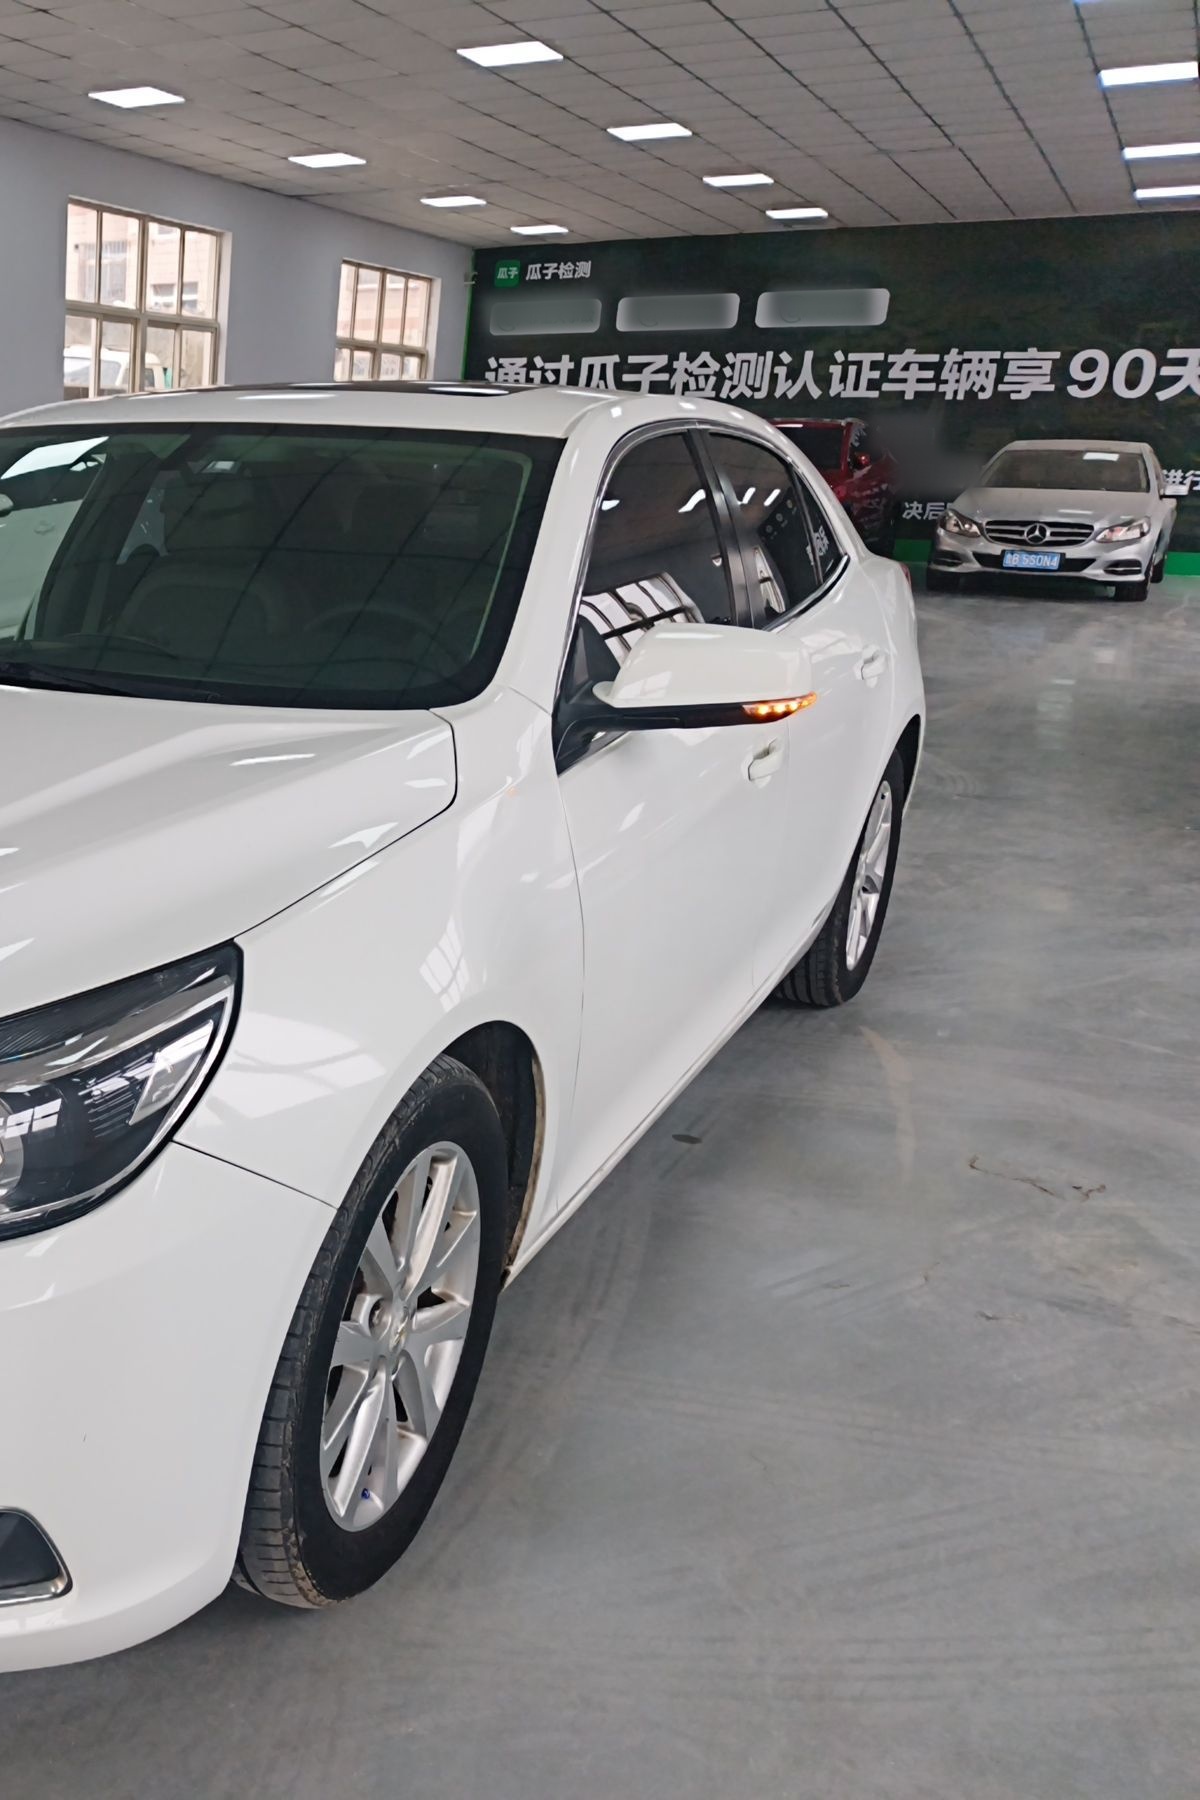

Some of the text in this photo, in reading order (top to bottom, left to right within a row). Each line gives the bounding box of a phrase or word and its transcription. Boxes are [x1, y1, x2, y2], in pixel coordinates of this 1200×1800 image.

[497, 267, 519, 280] 瓜子
[525, 260, 593, 281] 瓜子检测
[902, 500, 953, 520] 决后
